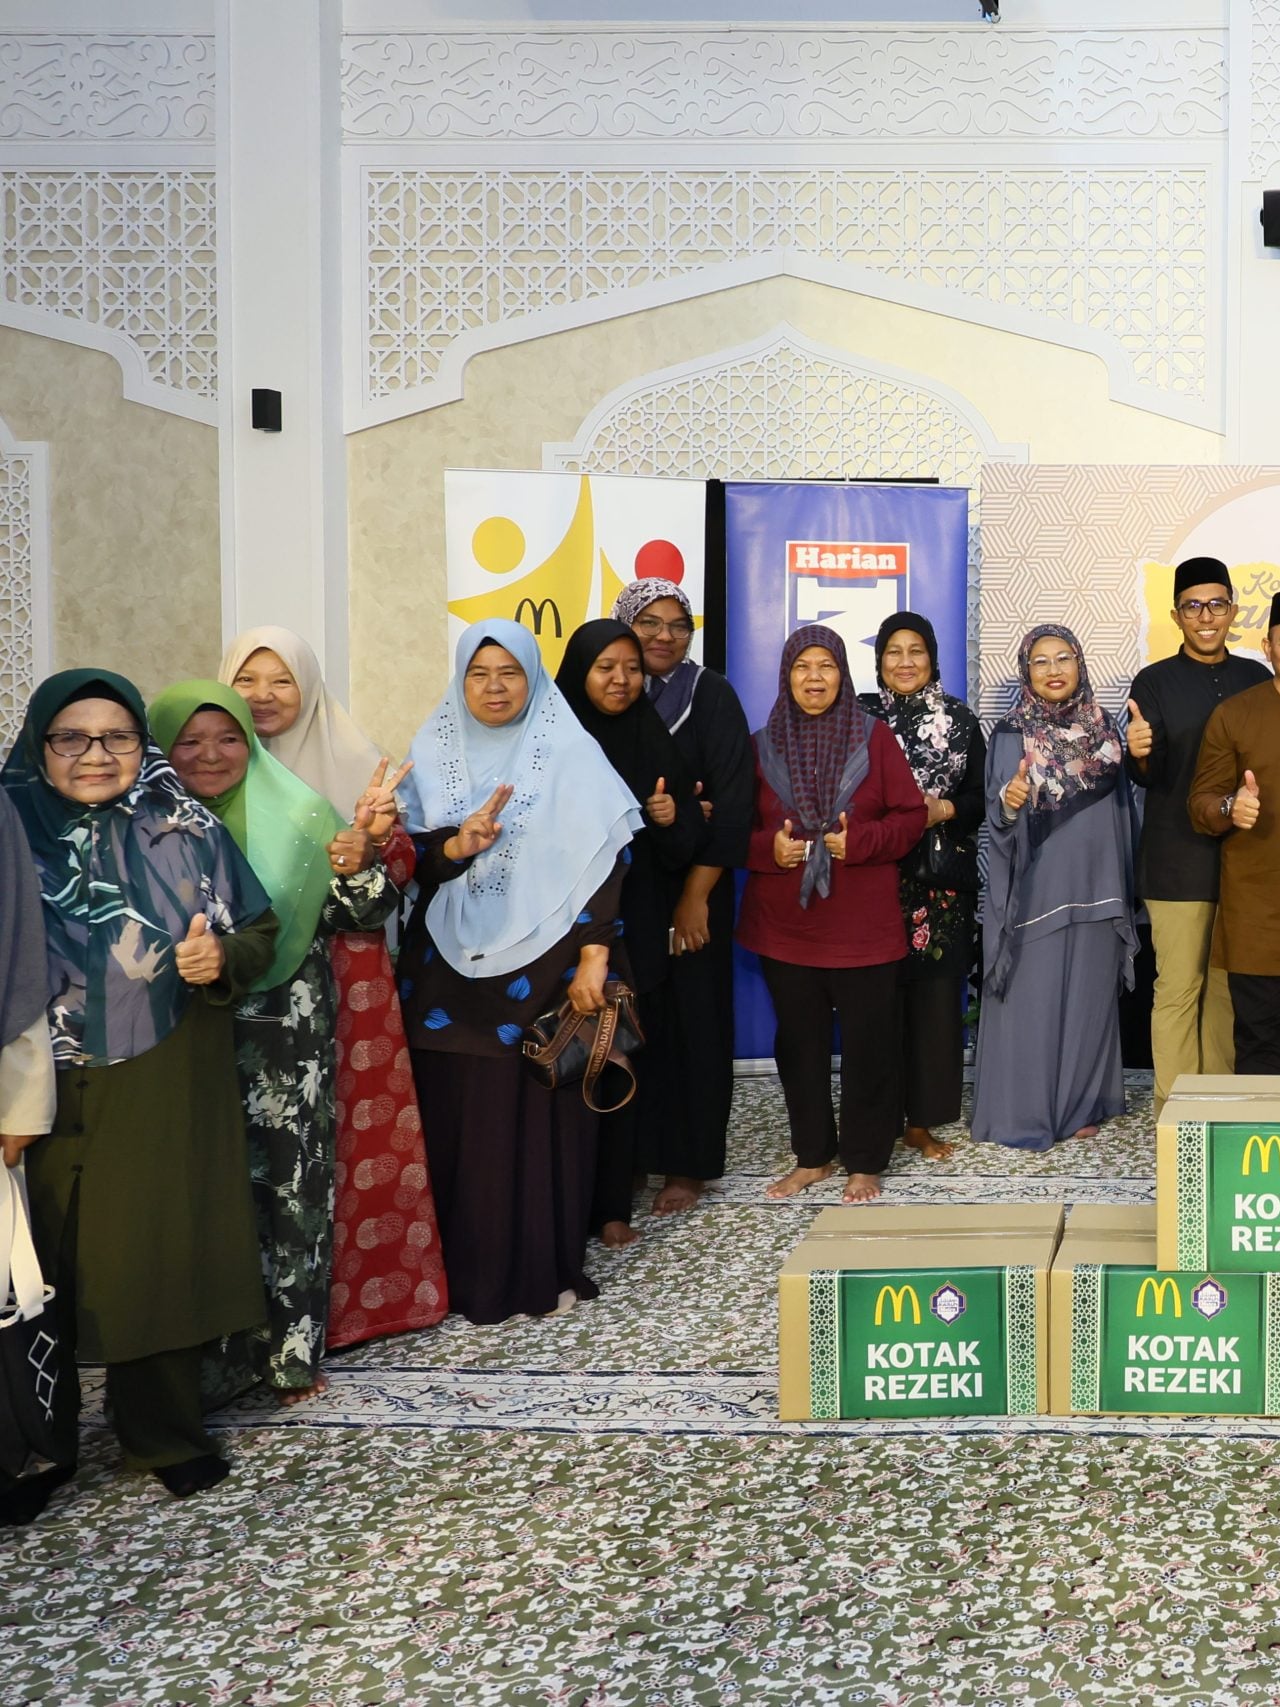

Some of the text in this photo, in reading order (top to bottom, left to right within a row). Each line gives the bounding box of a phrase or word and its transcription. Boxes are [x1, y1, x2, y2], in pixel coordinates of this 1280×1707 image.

[795, 546, 897, 570] Harian
[867, 1341, 980, 1369] KOTAK
[1128, 1335, 1240, 1363] KOTAK
[865, 1373, 983, 1401] REZEKI
[1124, 1367, 1242, 1394] REZEKI
